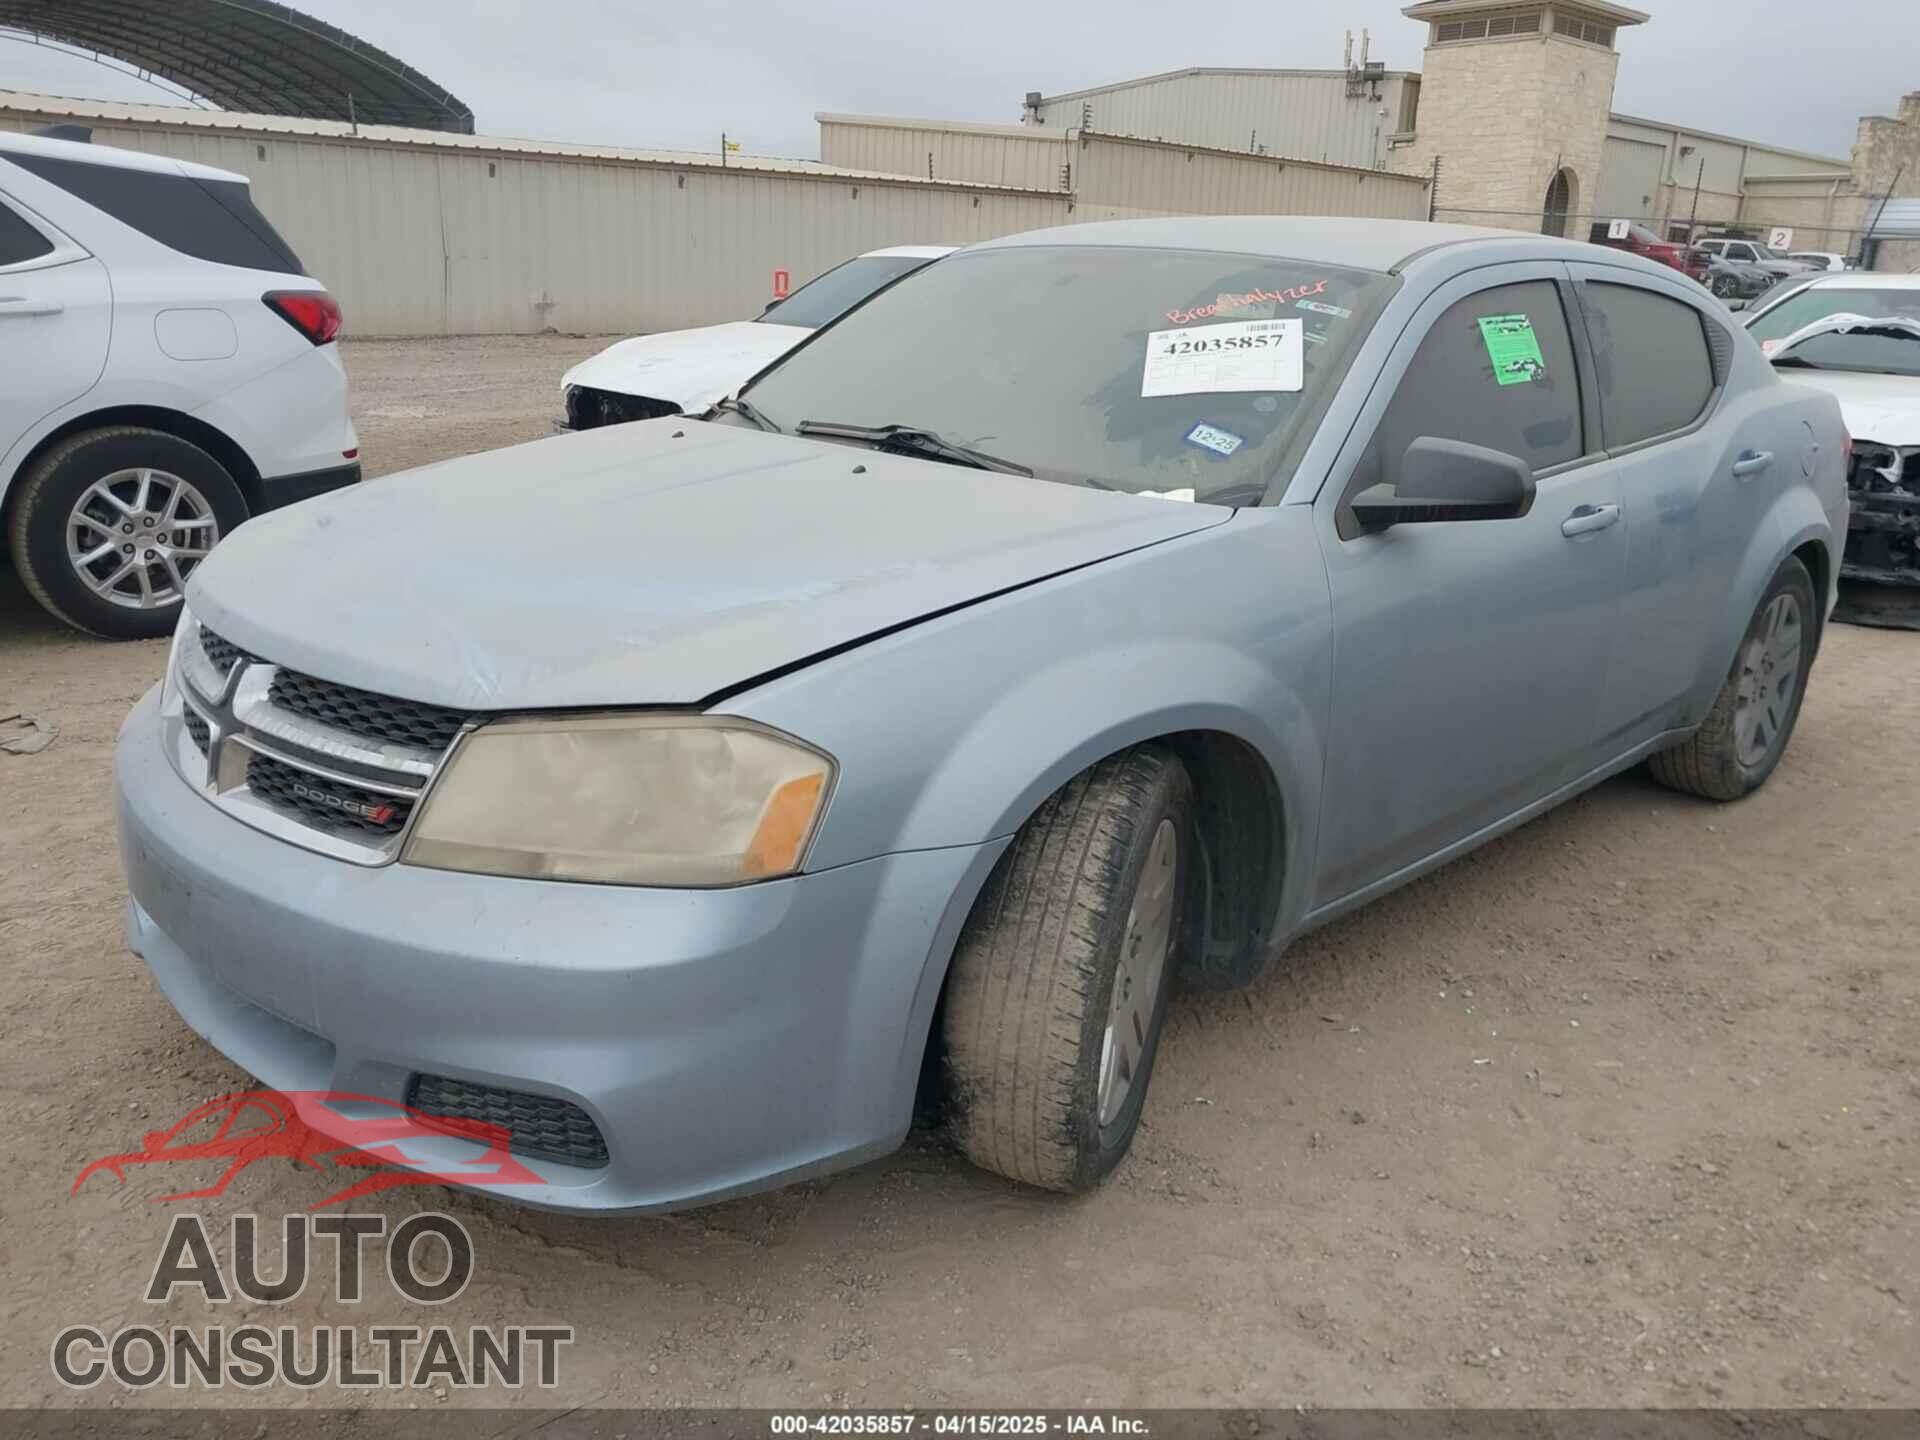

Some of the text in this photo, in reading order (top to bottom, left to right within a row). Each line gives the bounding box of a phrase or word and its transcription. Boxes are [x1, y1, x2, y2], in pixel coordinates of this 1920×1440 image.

[1773, 232, 1785, 245] 2
[1163, 334, 1284, 356] 42035857
[293, 783, 377, 820] DODGE
